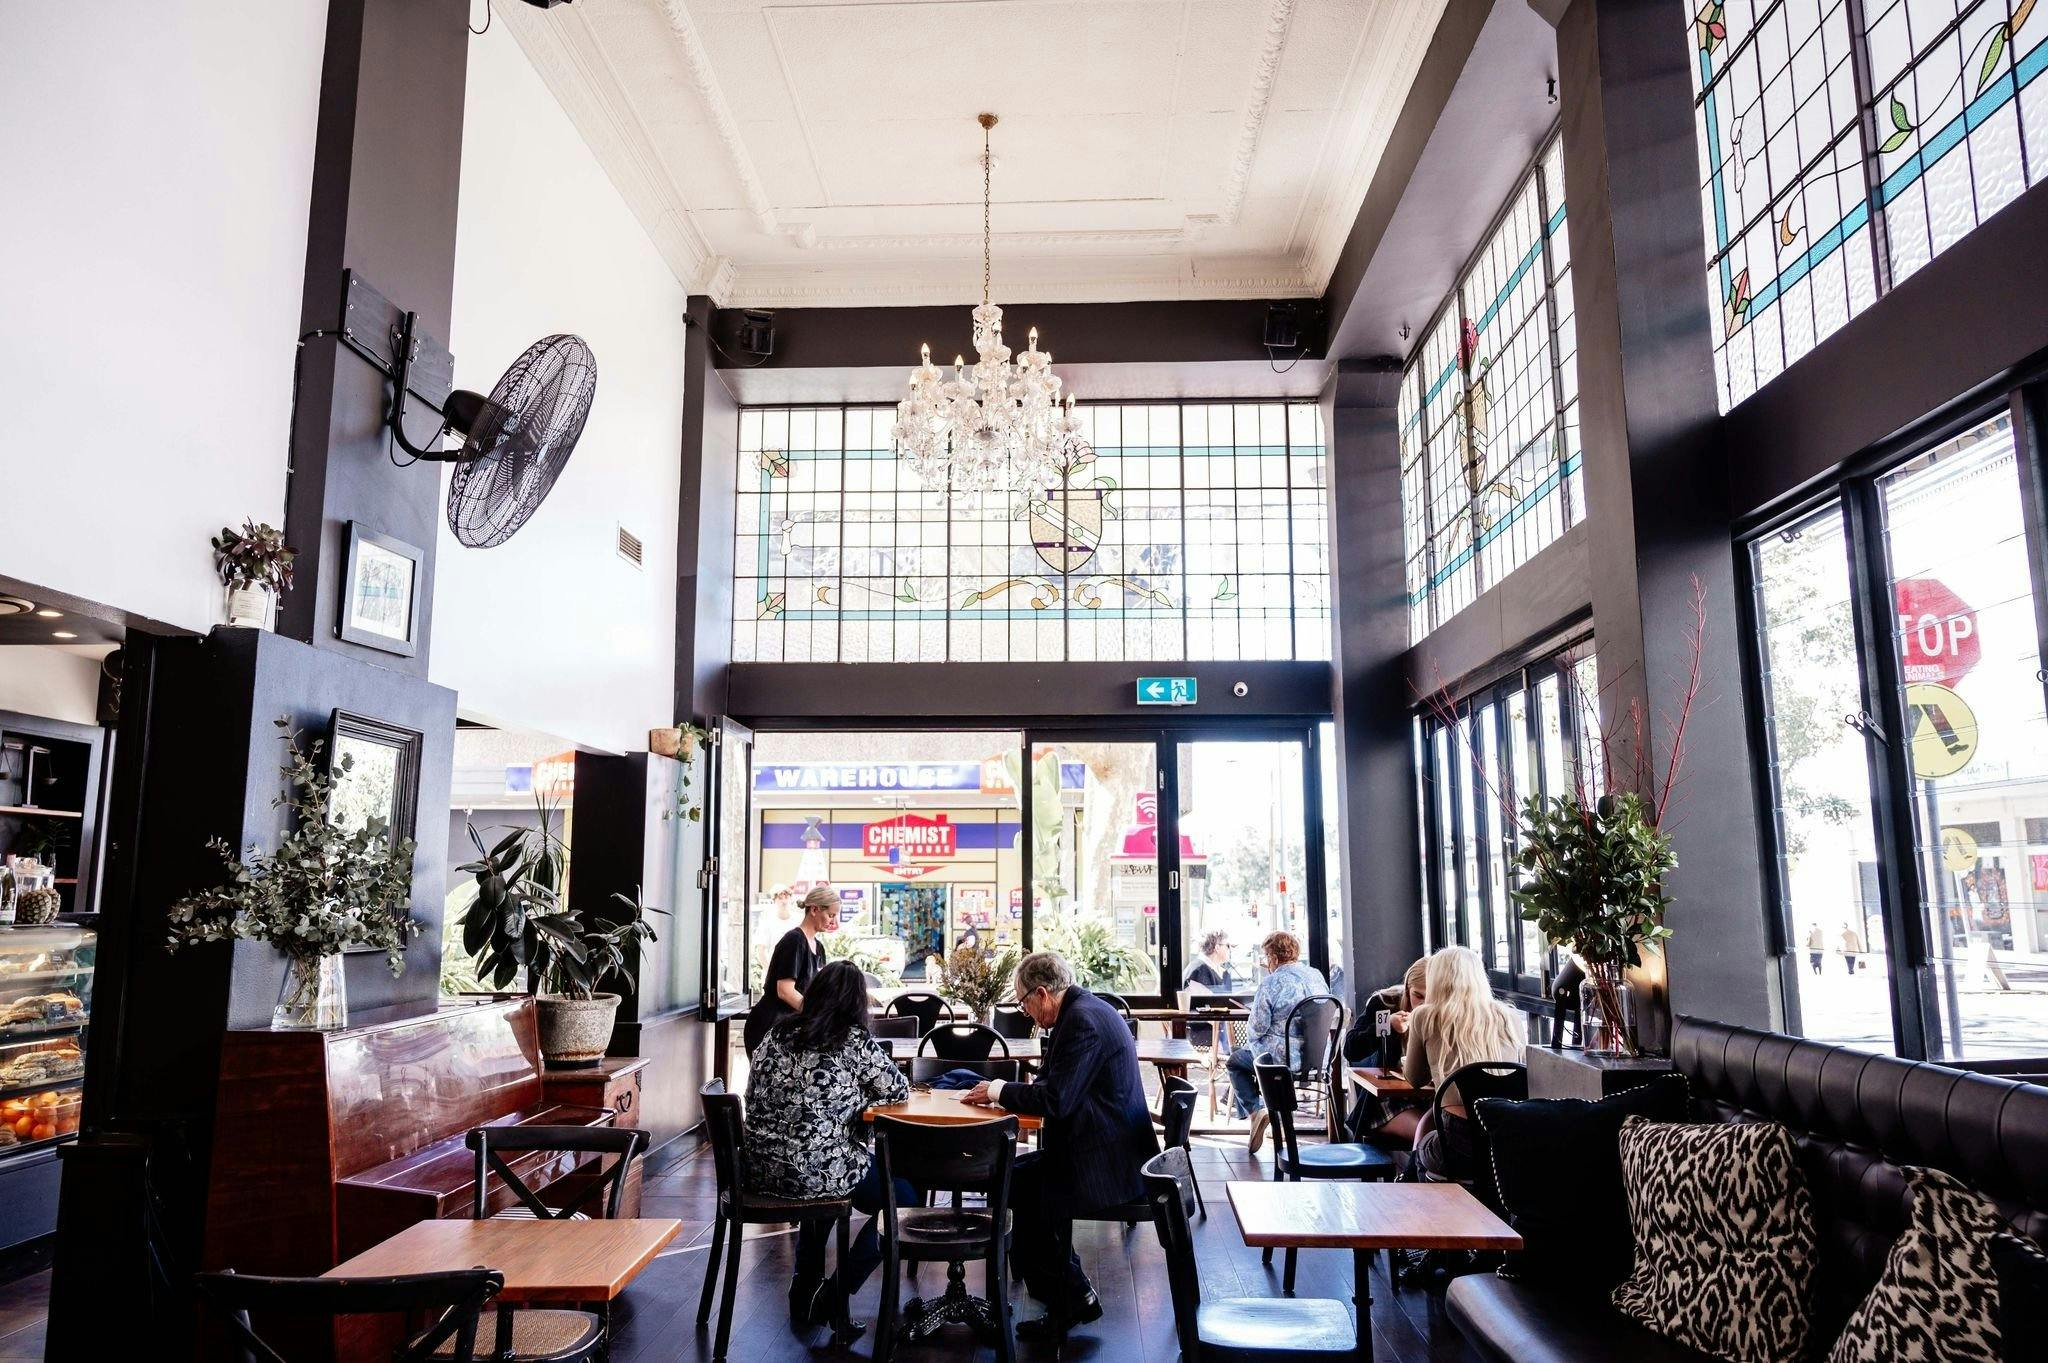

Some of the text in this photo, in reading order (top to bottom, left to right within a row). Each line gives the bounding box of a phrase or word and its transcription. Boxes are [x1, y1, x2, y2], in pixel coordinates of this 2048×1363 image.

[1899, 613, 1972, 657] TOP
[774, 768, 953, 788] WAREHOUSE
[869, 826, 950, 844] CHEMIST
[869, 845, 950, 853] WAHOUSE
[1377, 1013, 1388, 1024] 87
